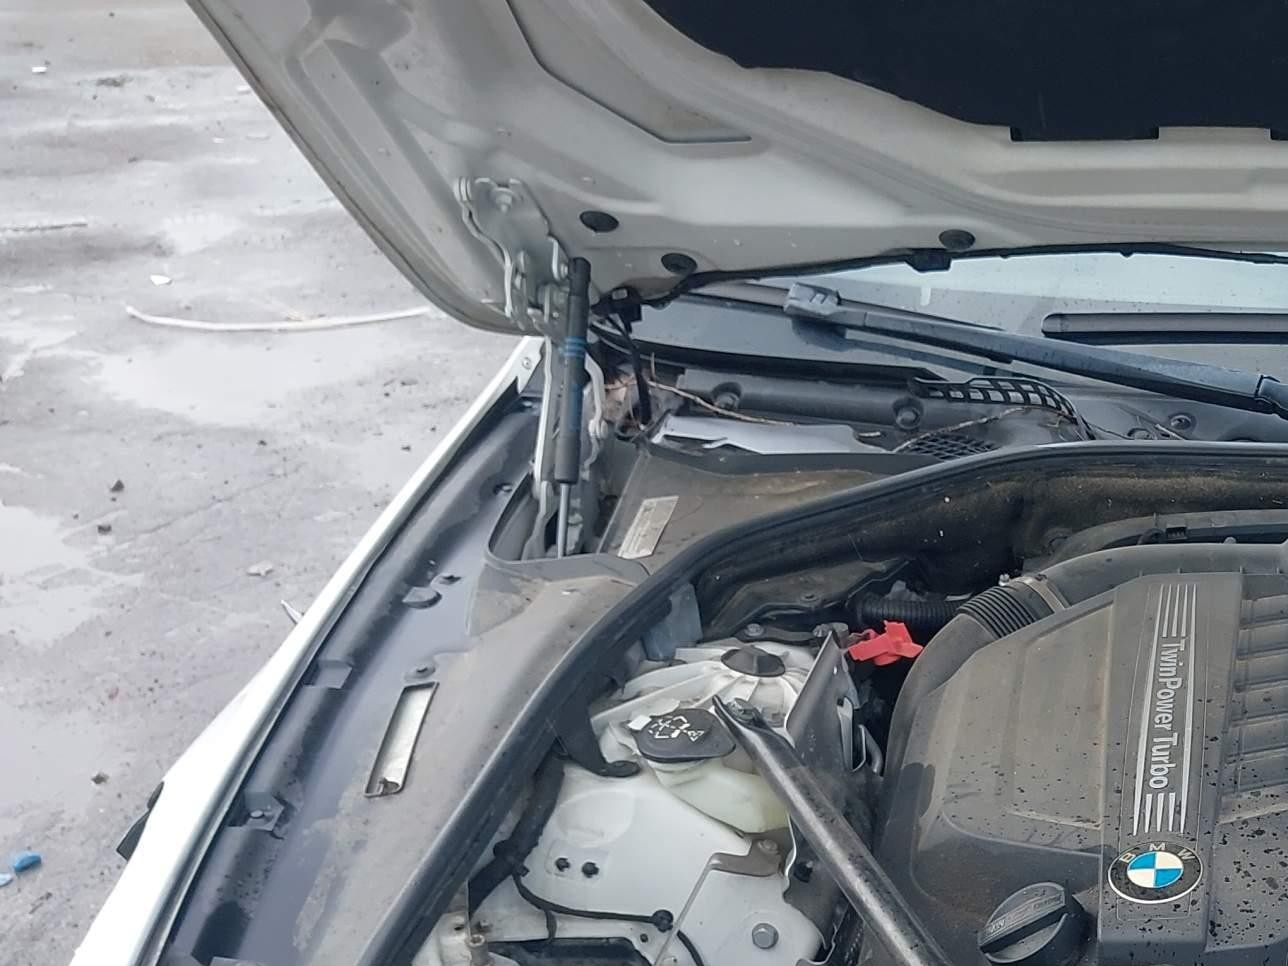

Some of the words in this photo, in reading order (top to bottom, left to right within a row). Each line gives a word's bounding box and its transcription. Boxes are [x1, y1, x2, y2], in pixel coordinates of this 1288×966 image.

[1154, 639, 1185, 731] TwinPower
[1149, 732, 1178, 790] Turbo
[1119, 842, 1197, 863] BMW
